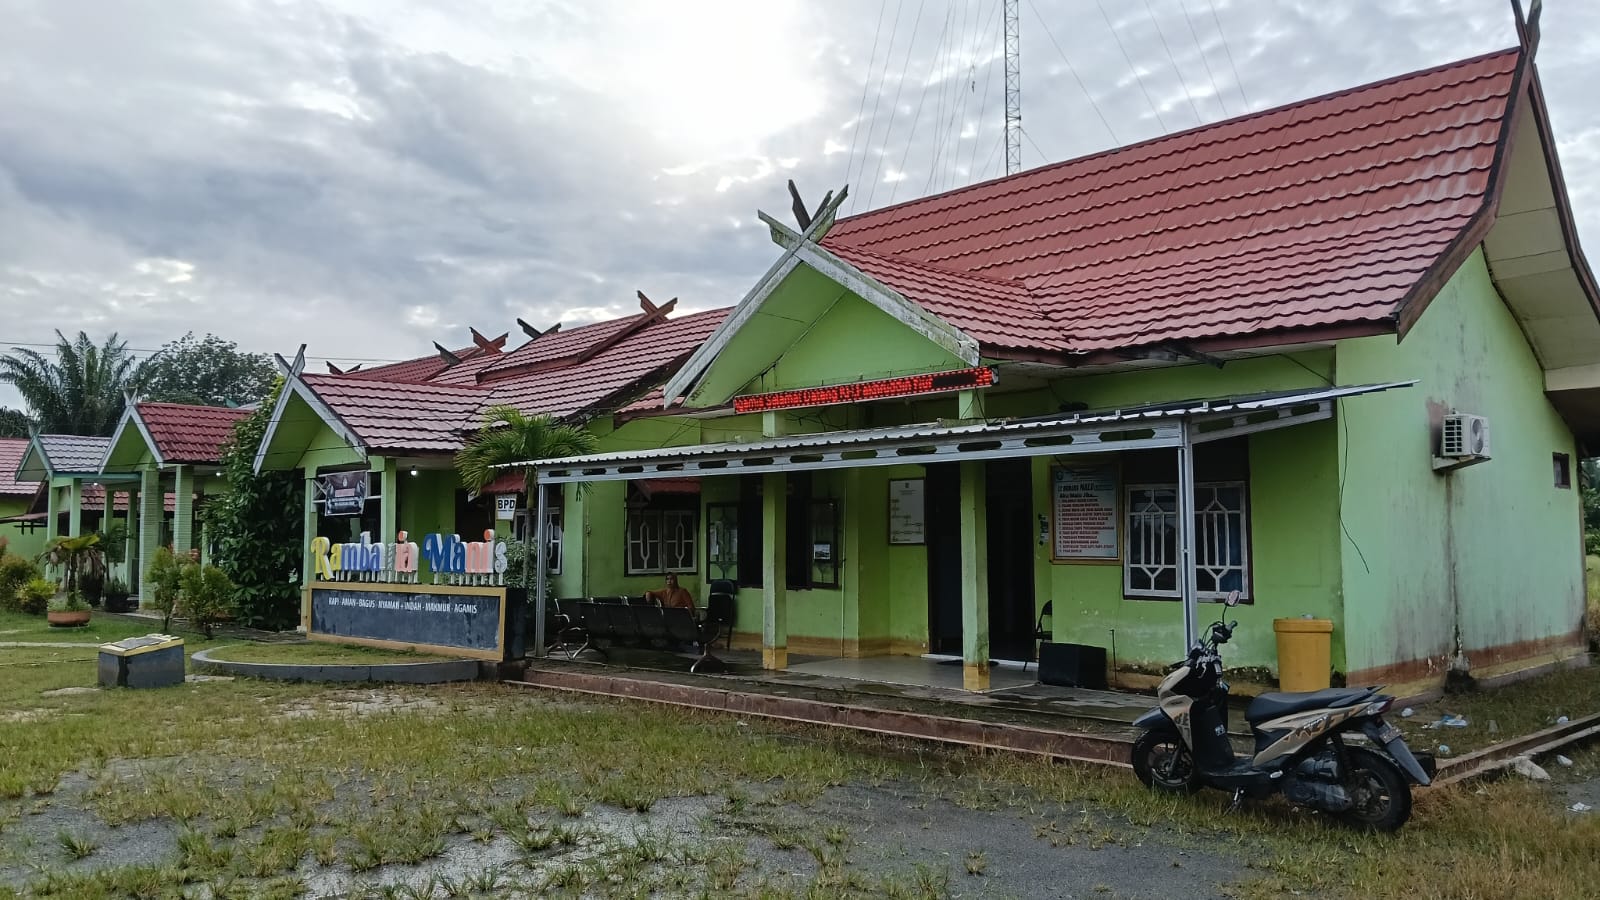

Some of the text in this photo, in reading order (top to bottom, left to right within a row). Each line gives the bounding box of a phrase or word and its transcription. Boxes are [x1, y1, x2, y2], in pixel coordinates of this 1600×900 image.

[497, 499, 515, 509] BPD
[423, 528, 508, 575] Manis
[358, 598, 375, 608] BAGUS
[454, 603, 478, 614] AGAMIS
